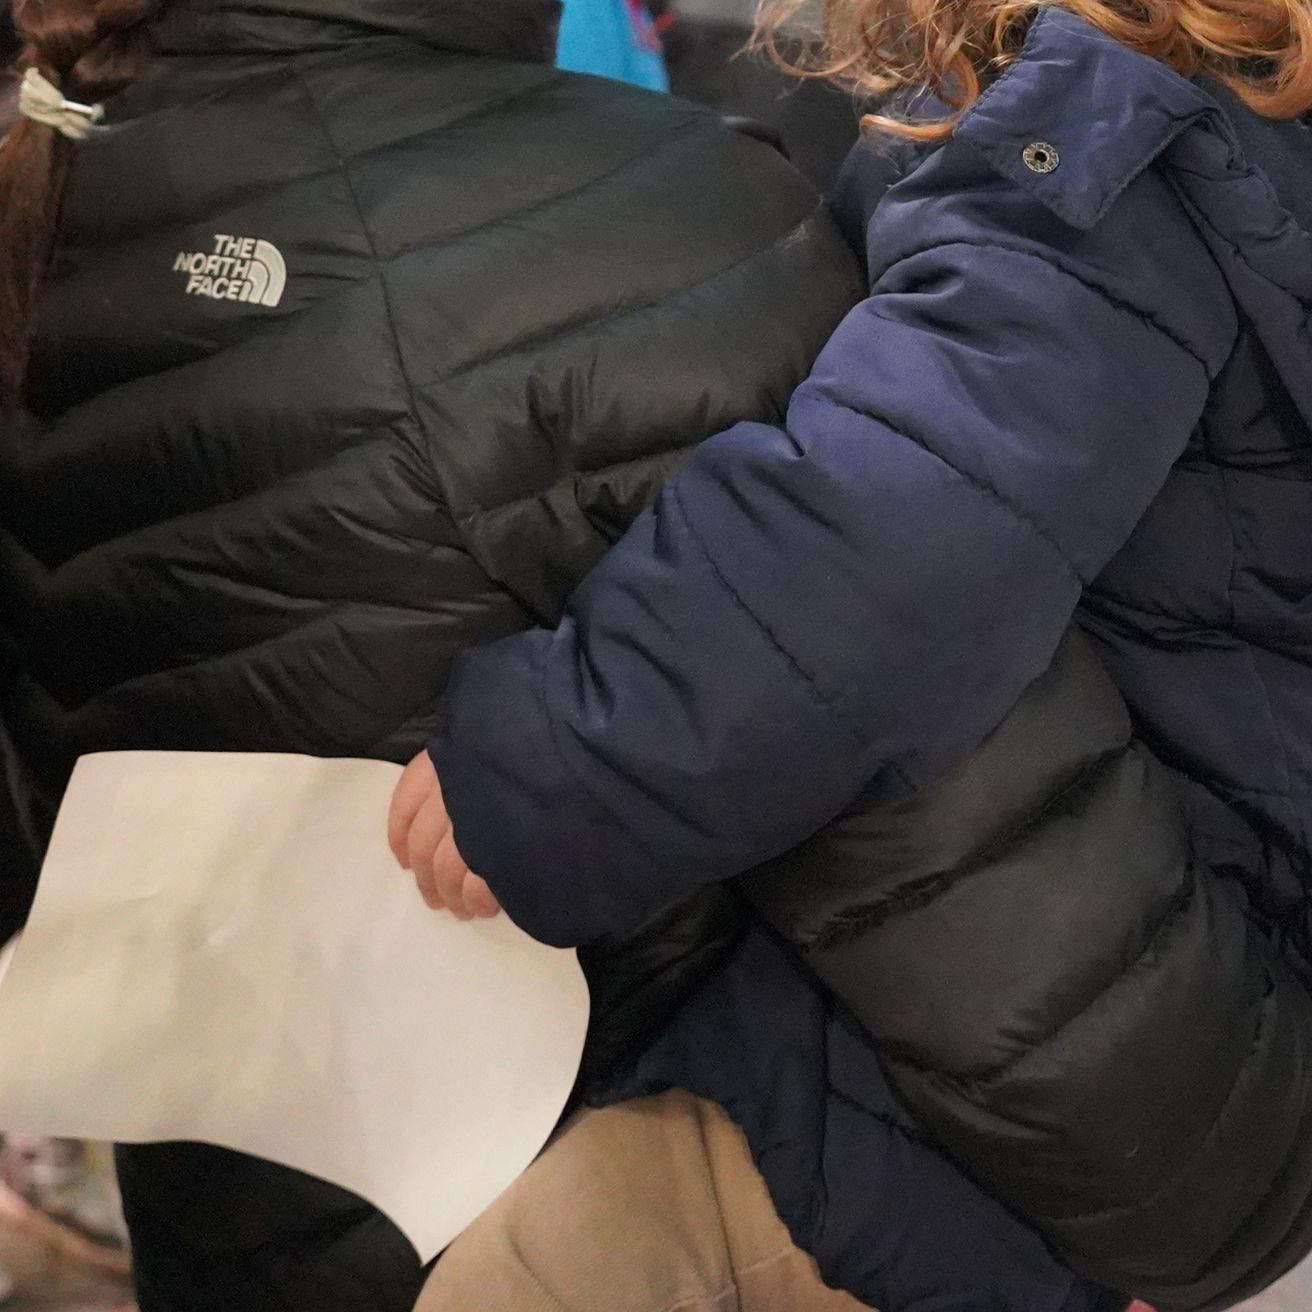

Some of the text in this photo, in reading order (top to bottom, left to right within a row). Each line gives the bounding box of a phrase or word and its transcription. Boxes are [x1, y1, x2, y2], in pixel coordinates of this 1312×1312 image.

[214, 234, 256, 258] THE
[172, 251, 251, 279] NORTH
[186, 275, 242, 299] FACE
